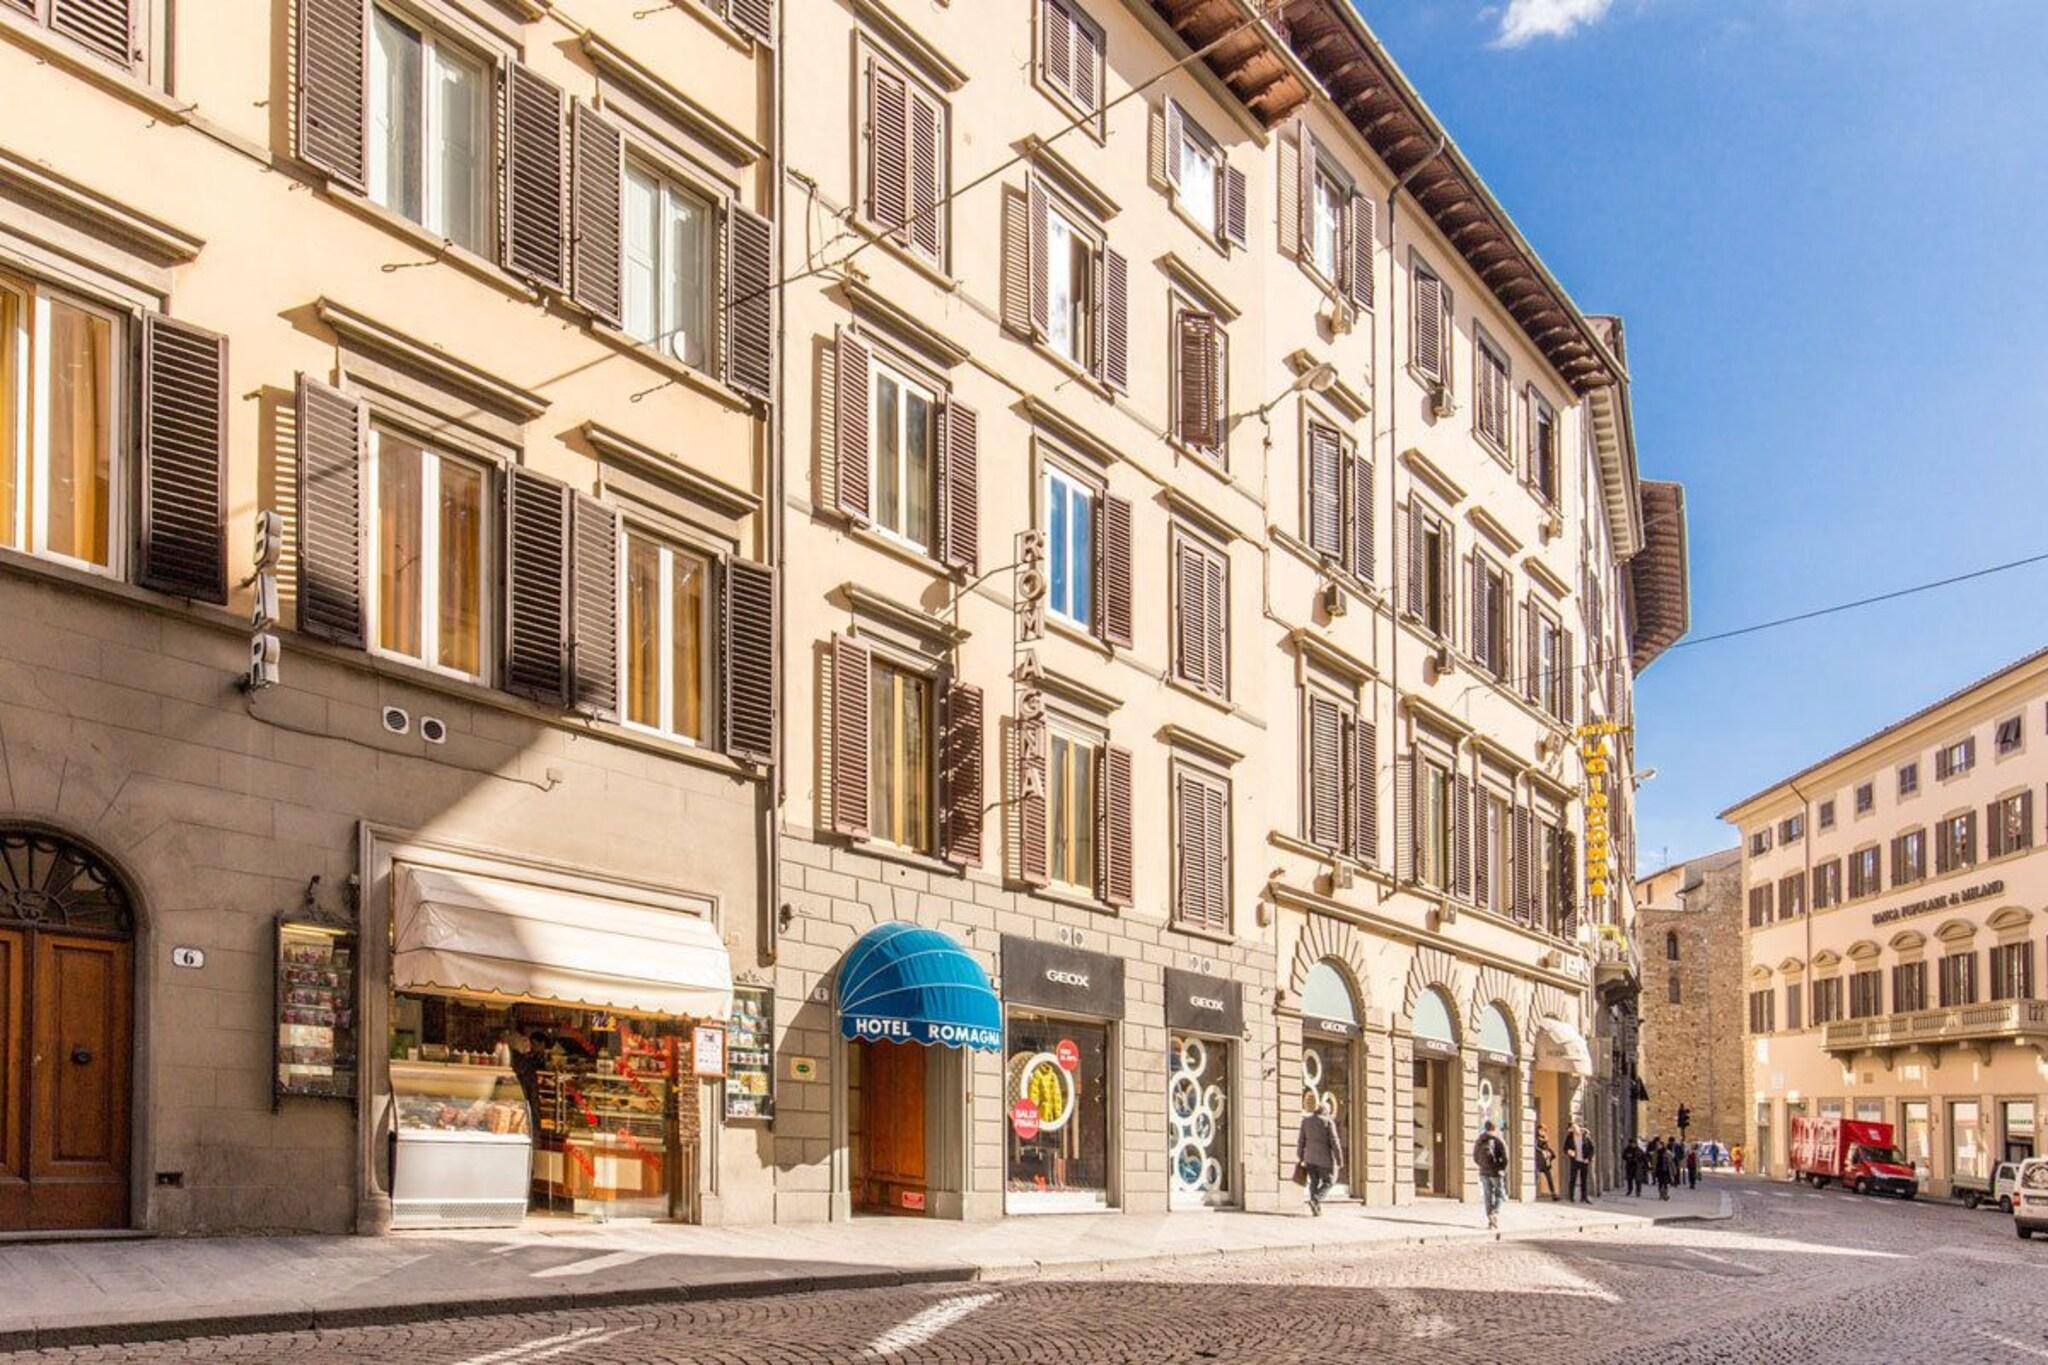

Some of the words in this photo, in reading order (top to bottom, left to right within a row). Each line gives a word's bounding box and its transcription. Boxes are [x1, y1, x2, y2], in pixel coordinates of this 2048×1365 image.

[250, 511, 283, 687] BAR
[1018, 529, 1045, 798] ROMAGNA
[1961, 880, 2004, 901] MILANO
[183, 951, 195, 965] 6
[1046, 969, 1089, 987] GEOX
[1190, 996, 1224, 1011] GEOX
[856, 1018, 911, 1036] HOTEL
